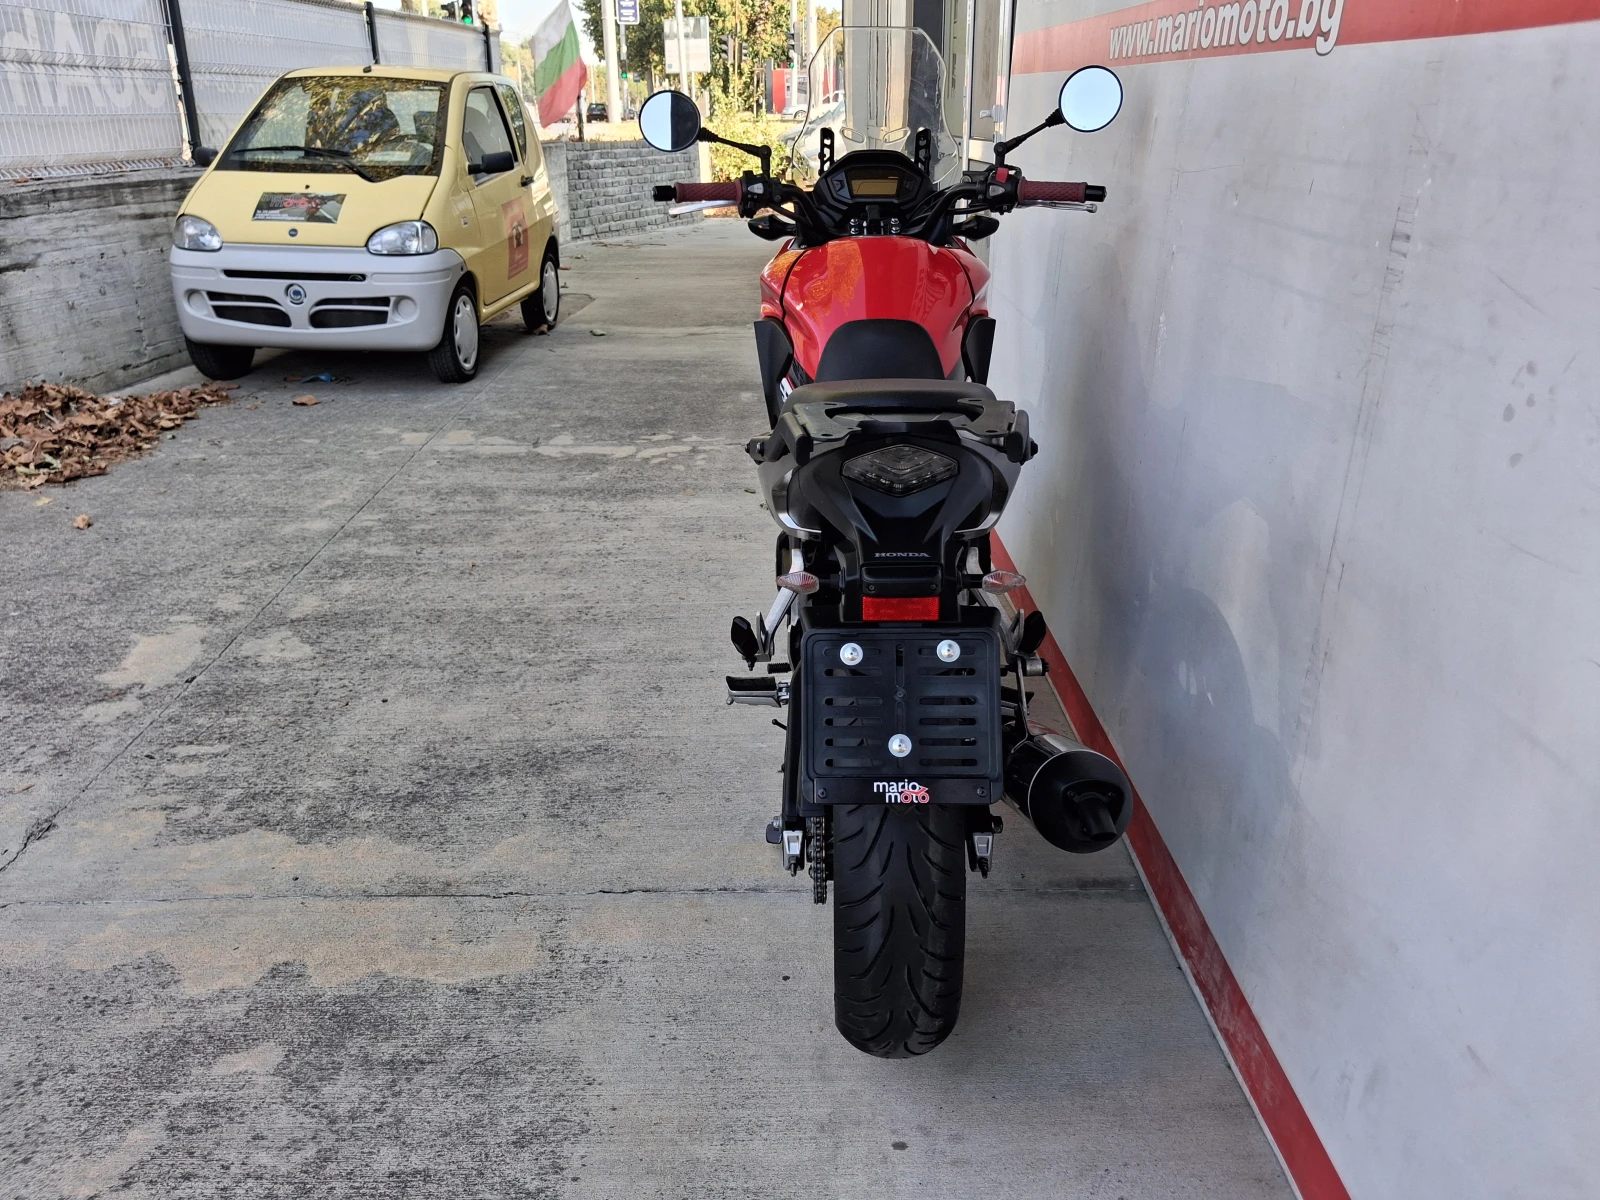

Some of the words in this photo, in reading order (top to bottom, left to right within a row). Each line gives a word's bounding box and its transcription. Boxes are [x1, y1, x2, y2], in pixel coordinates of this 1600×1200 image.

[1109, 0, 1345, 60] www.mariomoto.bg
[873, 778, 920, 793] mario
[885, 792, 930, 804] moto
